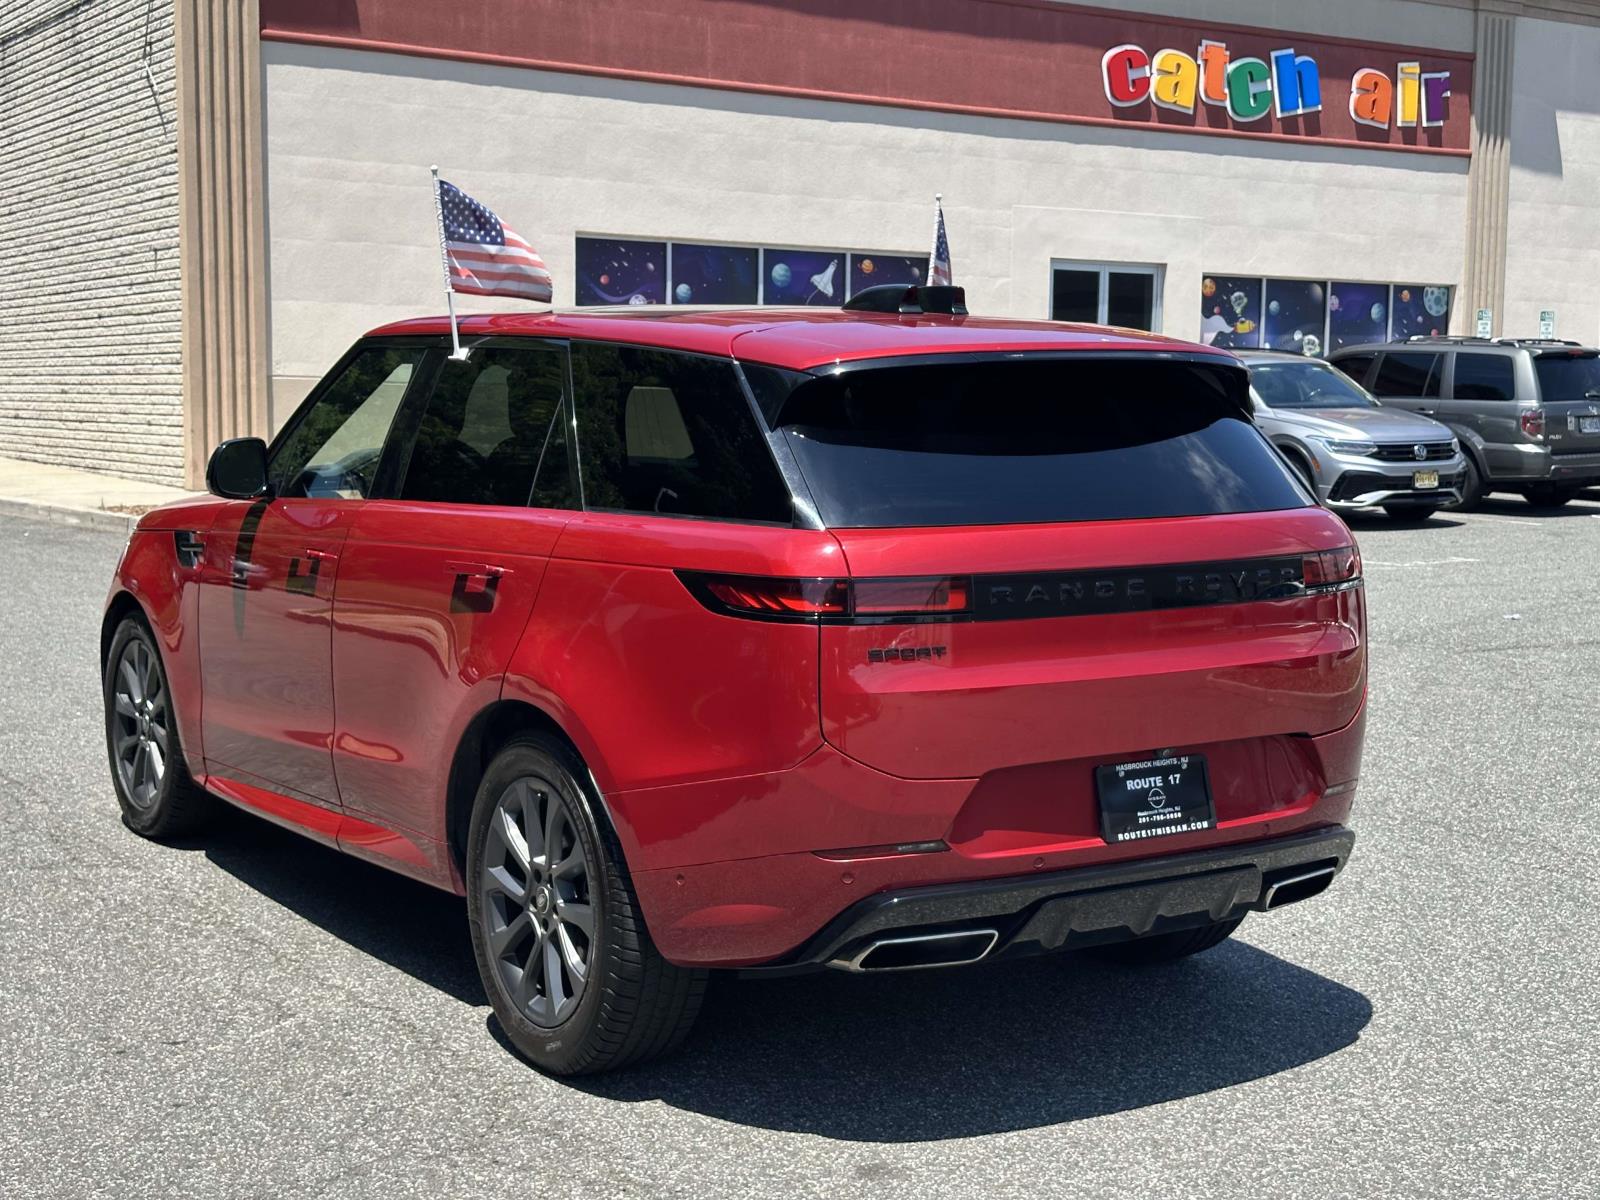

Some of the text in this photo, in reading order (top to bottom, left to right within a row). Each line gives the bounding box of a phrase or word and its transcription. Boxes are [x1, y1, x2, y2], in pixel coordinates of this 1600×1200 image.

[1102, 39, 1451, 129] catch air
[989, 566, 1296, 606] RANGE ROVER
[868, 645, 947, 663] SPORT
[1116, 761, 1152, 772] HASBROUCK
[1126, 774, 1180, 790] ROUTE 17
[1118, 821, 1208, 840] ROUTE17NISSAN.COM
